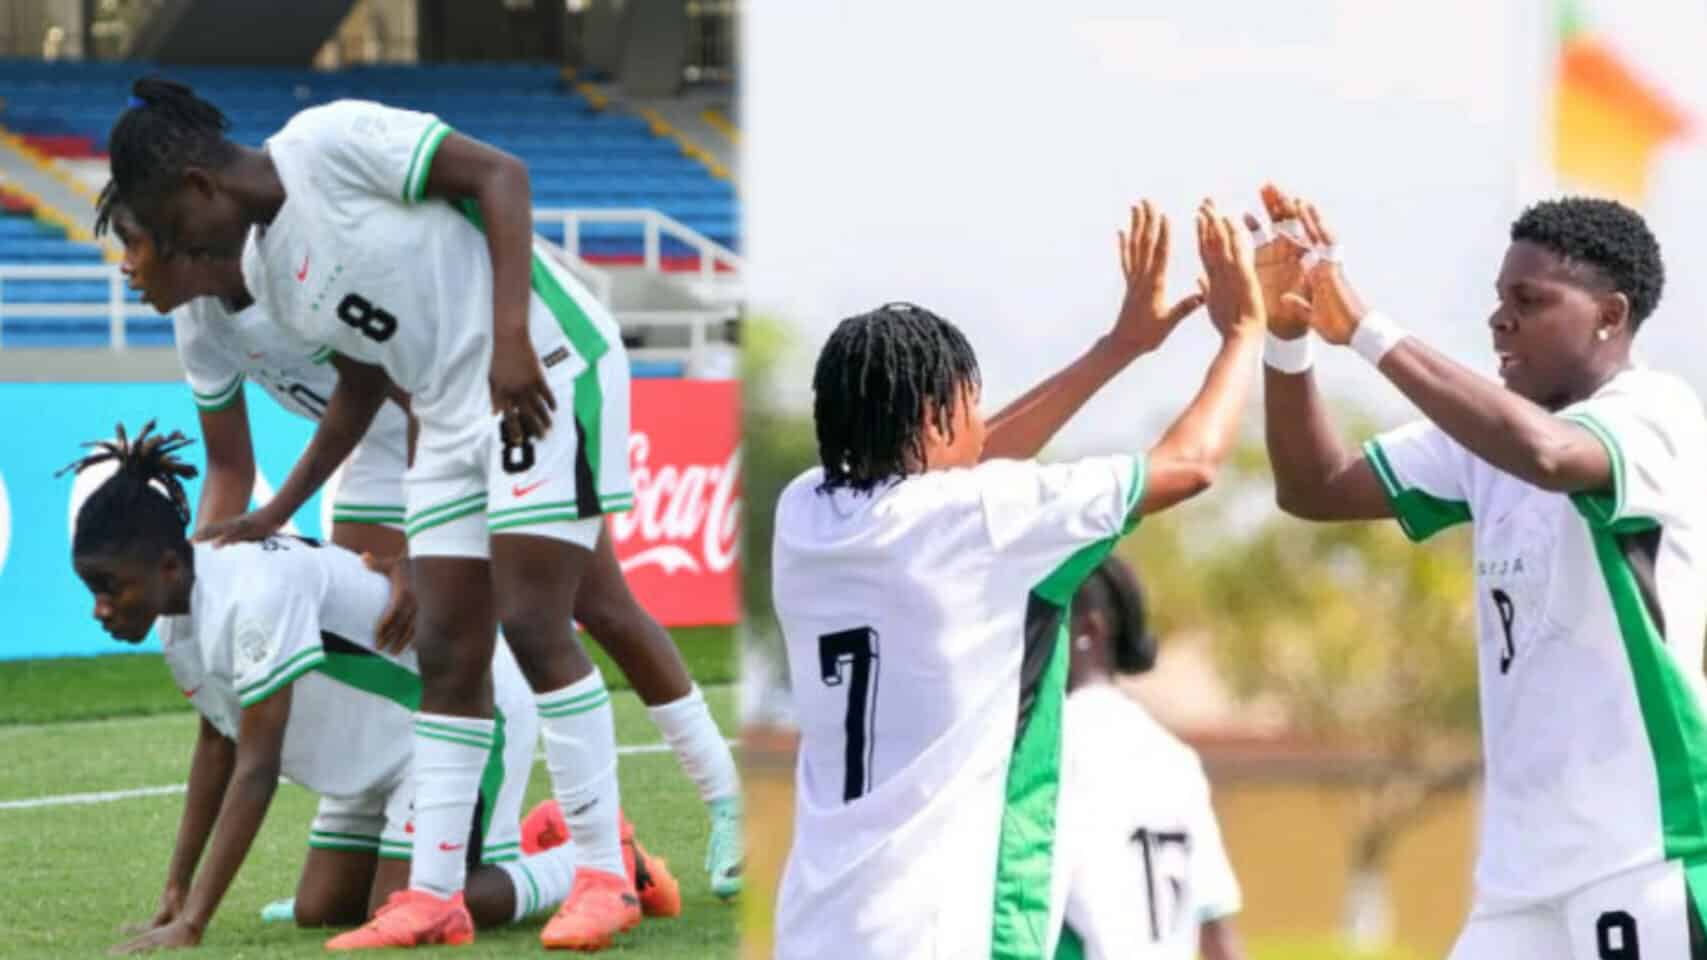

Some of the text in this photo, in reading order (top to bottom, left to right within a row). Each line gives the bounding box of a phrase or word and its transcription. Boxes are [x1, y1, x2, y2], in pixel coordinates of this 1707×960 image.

[337, 292, 398, 343] 8
[818, 624, 880, 805] 7
[1129, 826, 1190, 941] 17
